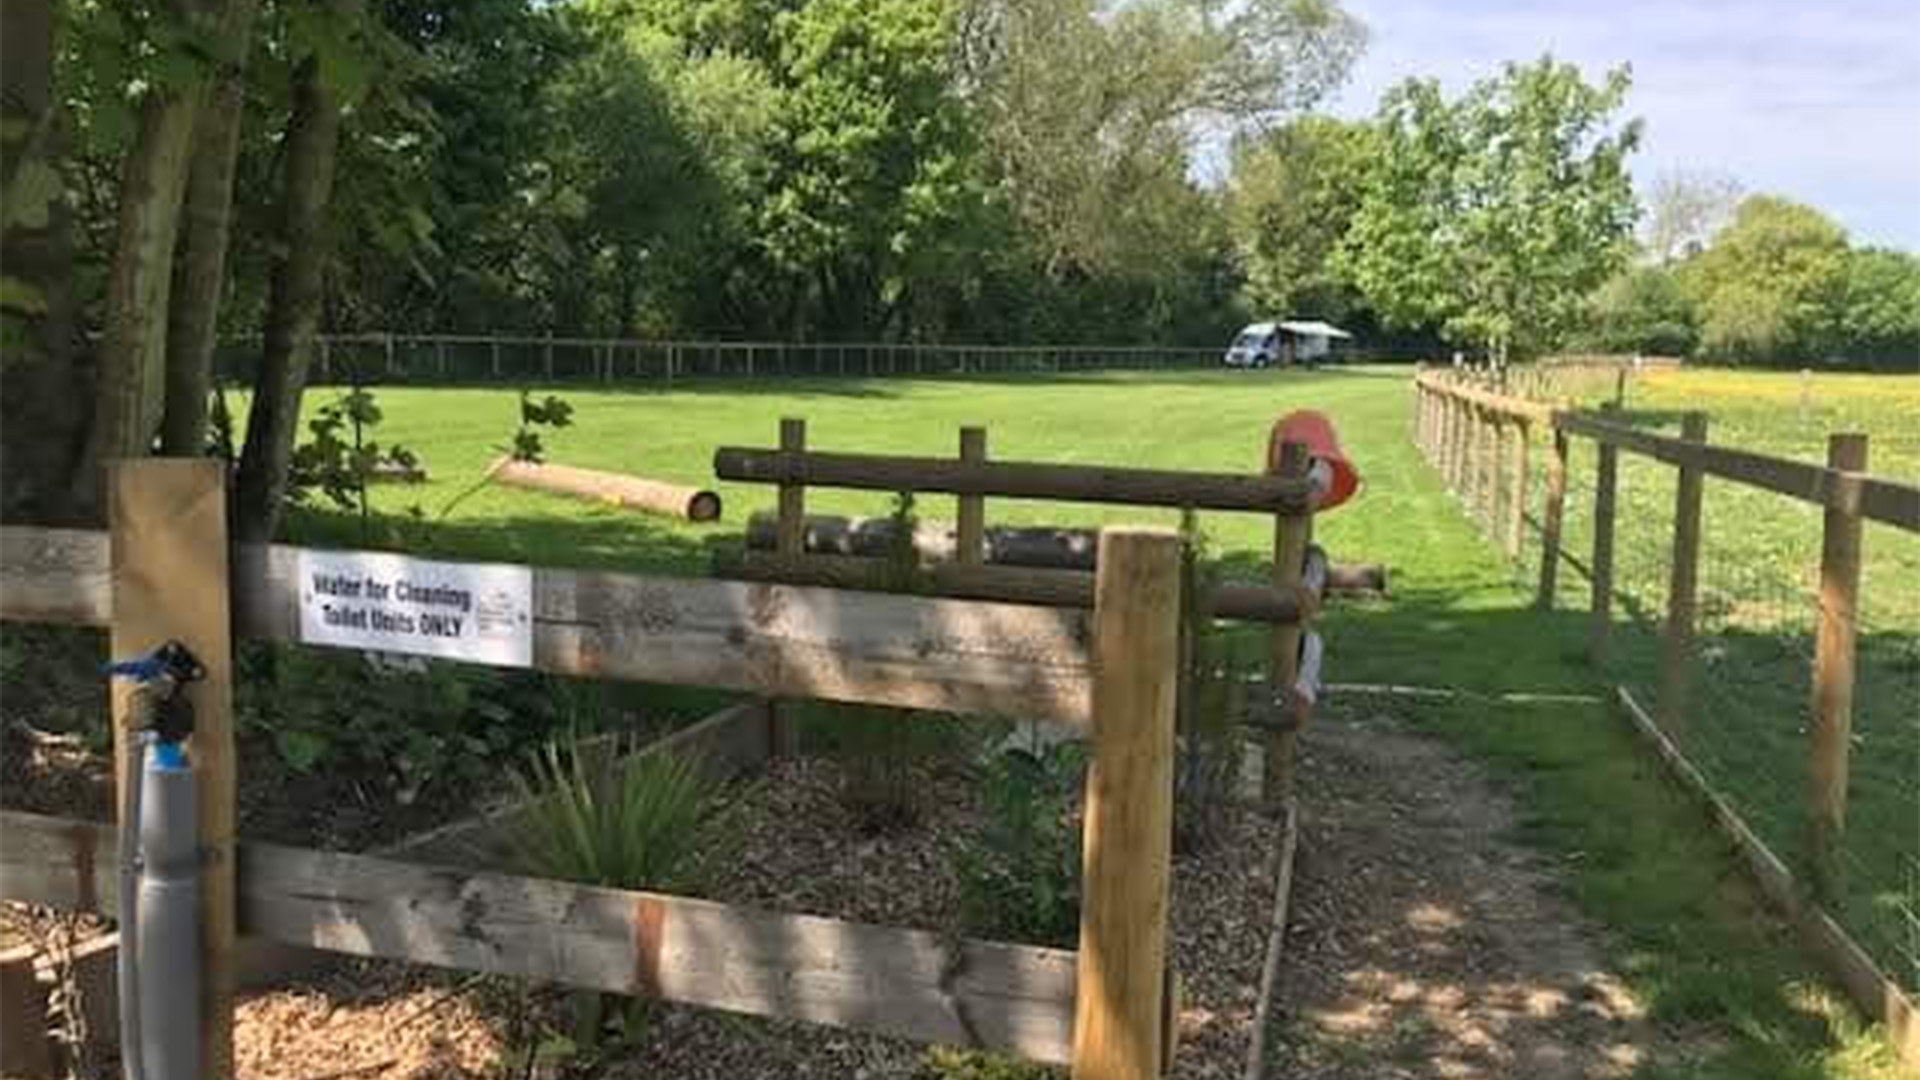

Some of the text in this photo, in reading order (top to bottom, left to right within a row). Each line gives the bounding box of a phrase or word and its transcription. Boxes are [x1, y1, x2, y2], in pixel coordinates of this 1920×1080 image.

[313, 572, 361, 596] Water
[366, 576, 389, 600] for
[395, 580, 471, 611] Cleaning
[323, 606, 463, 637] Toilet Units ONLY
